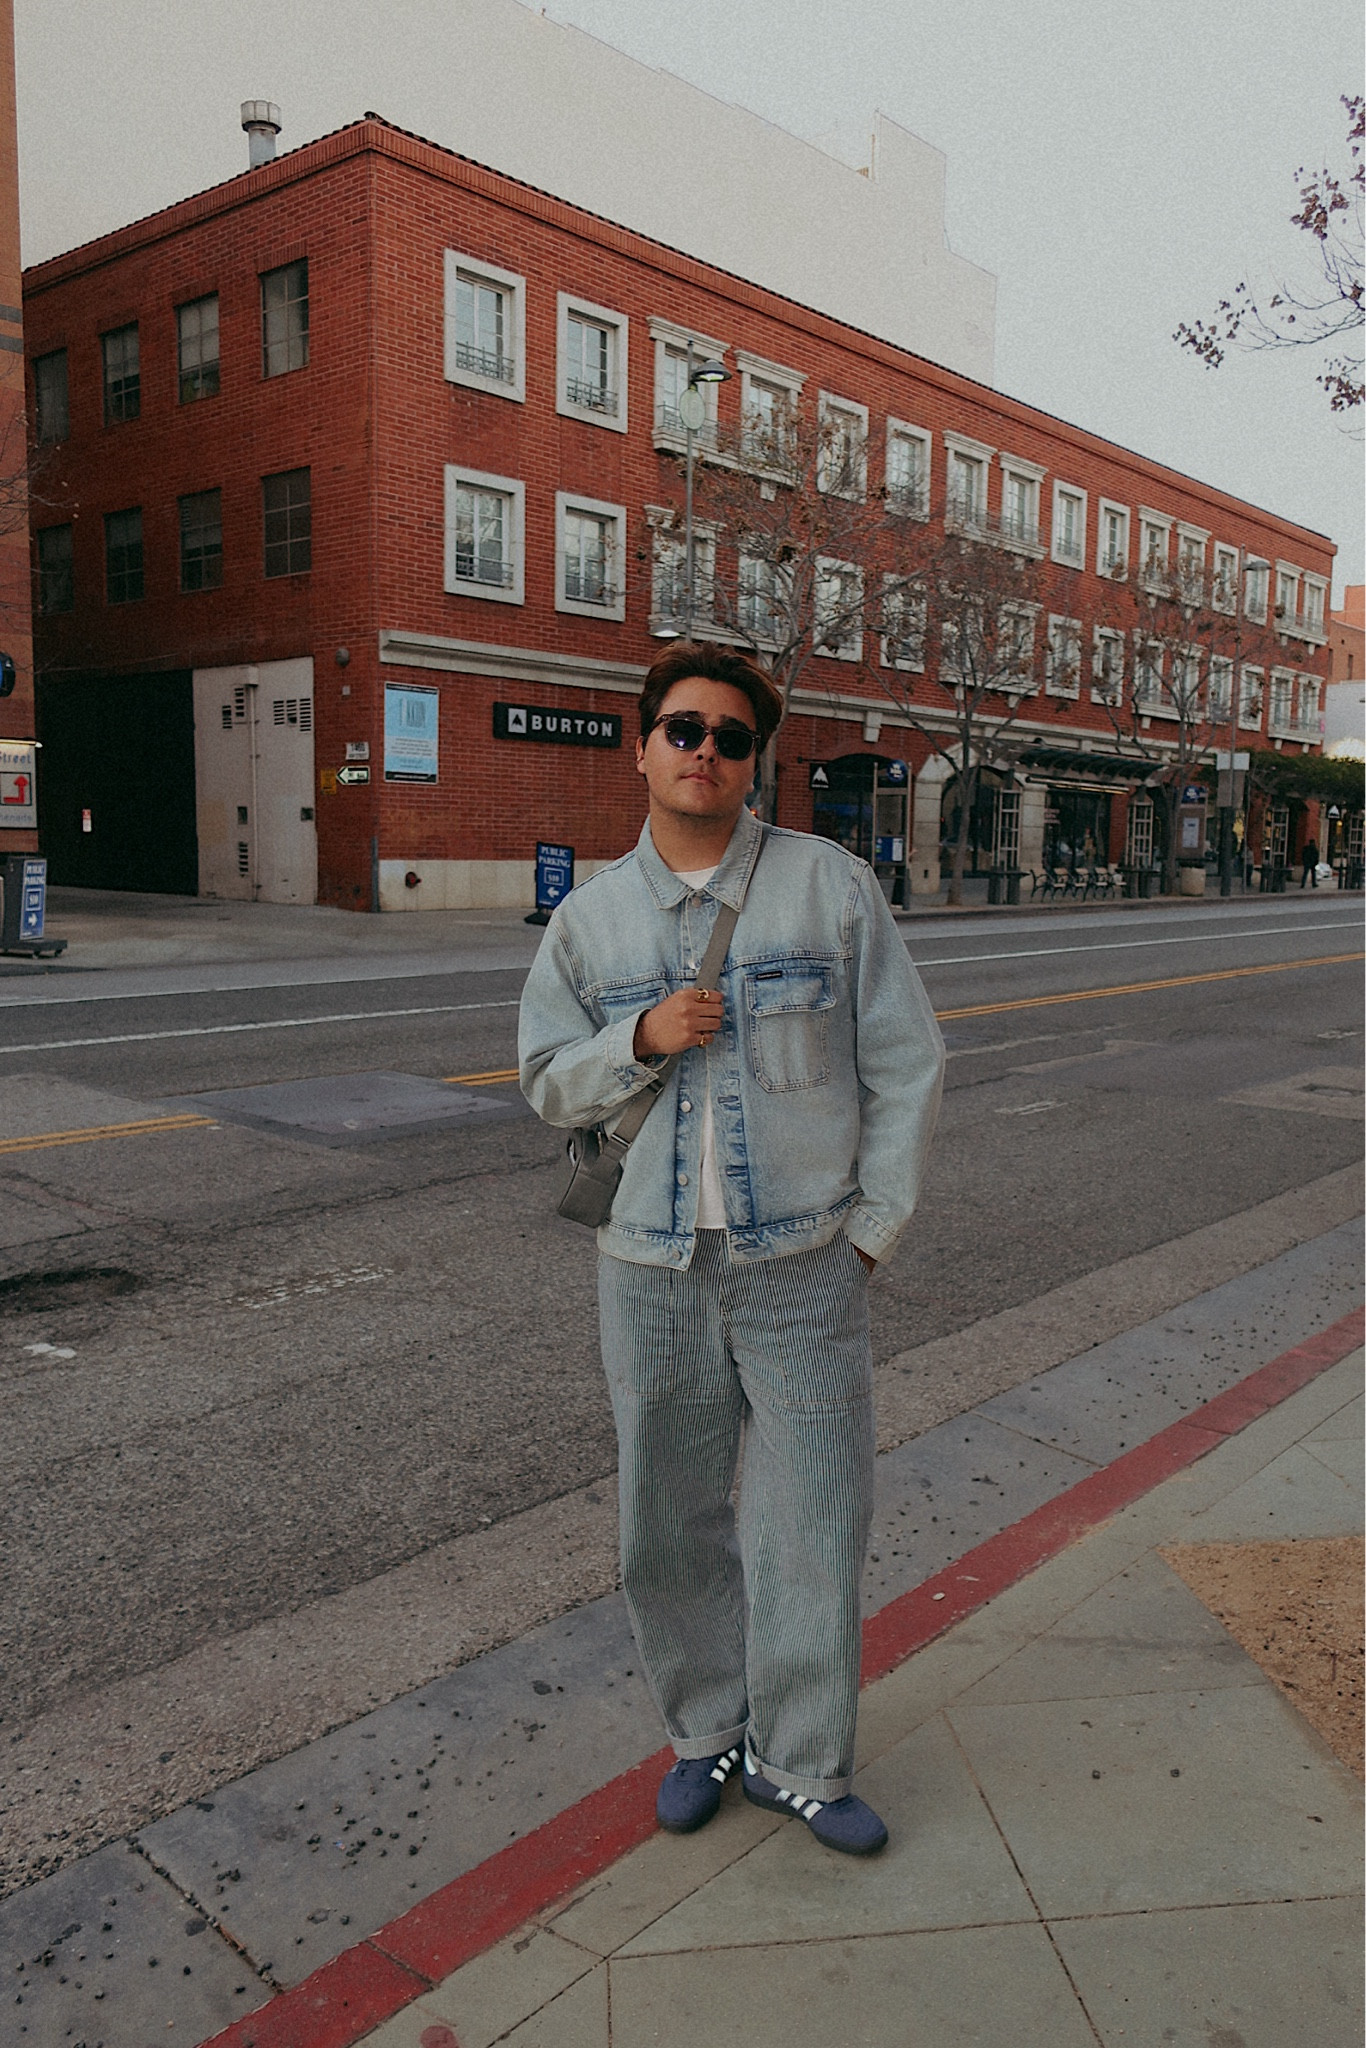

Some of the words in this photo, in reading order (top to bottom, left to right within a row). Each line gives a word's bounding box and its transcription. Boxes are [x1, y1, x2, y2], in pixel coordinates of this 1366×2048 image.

[532, 715, 612, 737] BURTON
[541, 846, 568, 857] PUBLIC
[538, 855, 570, 868] PARKING
